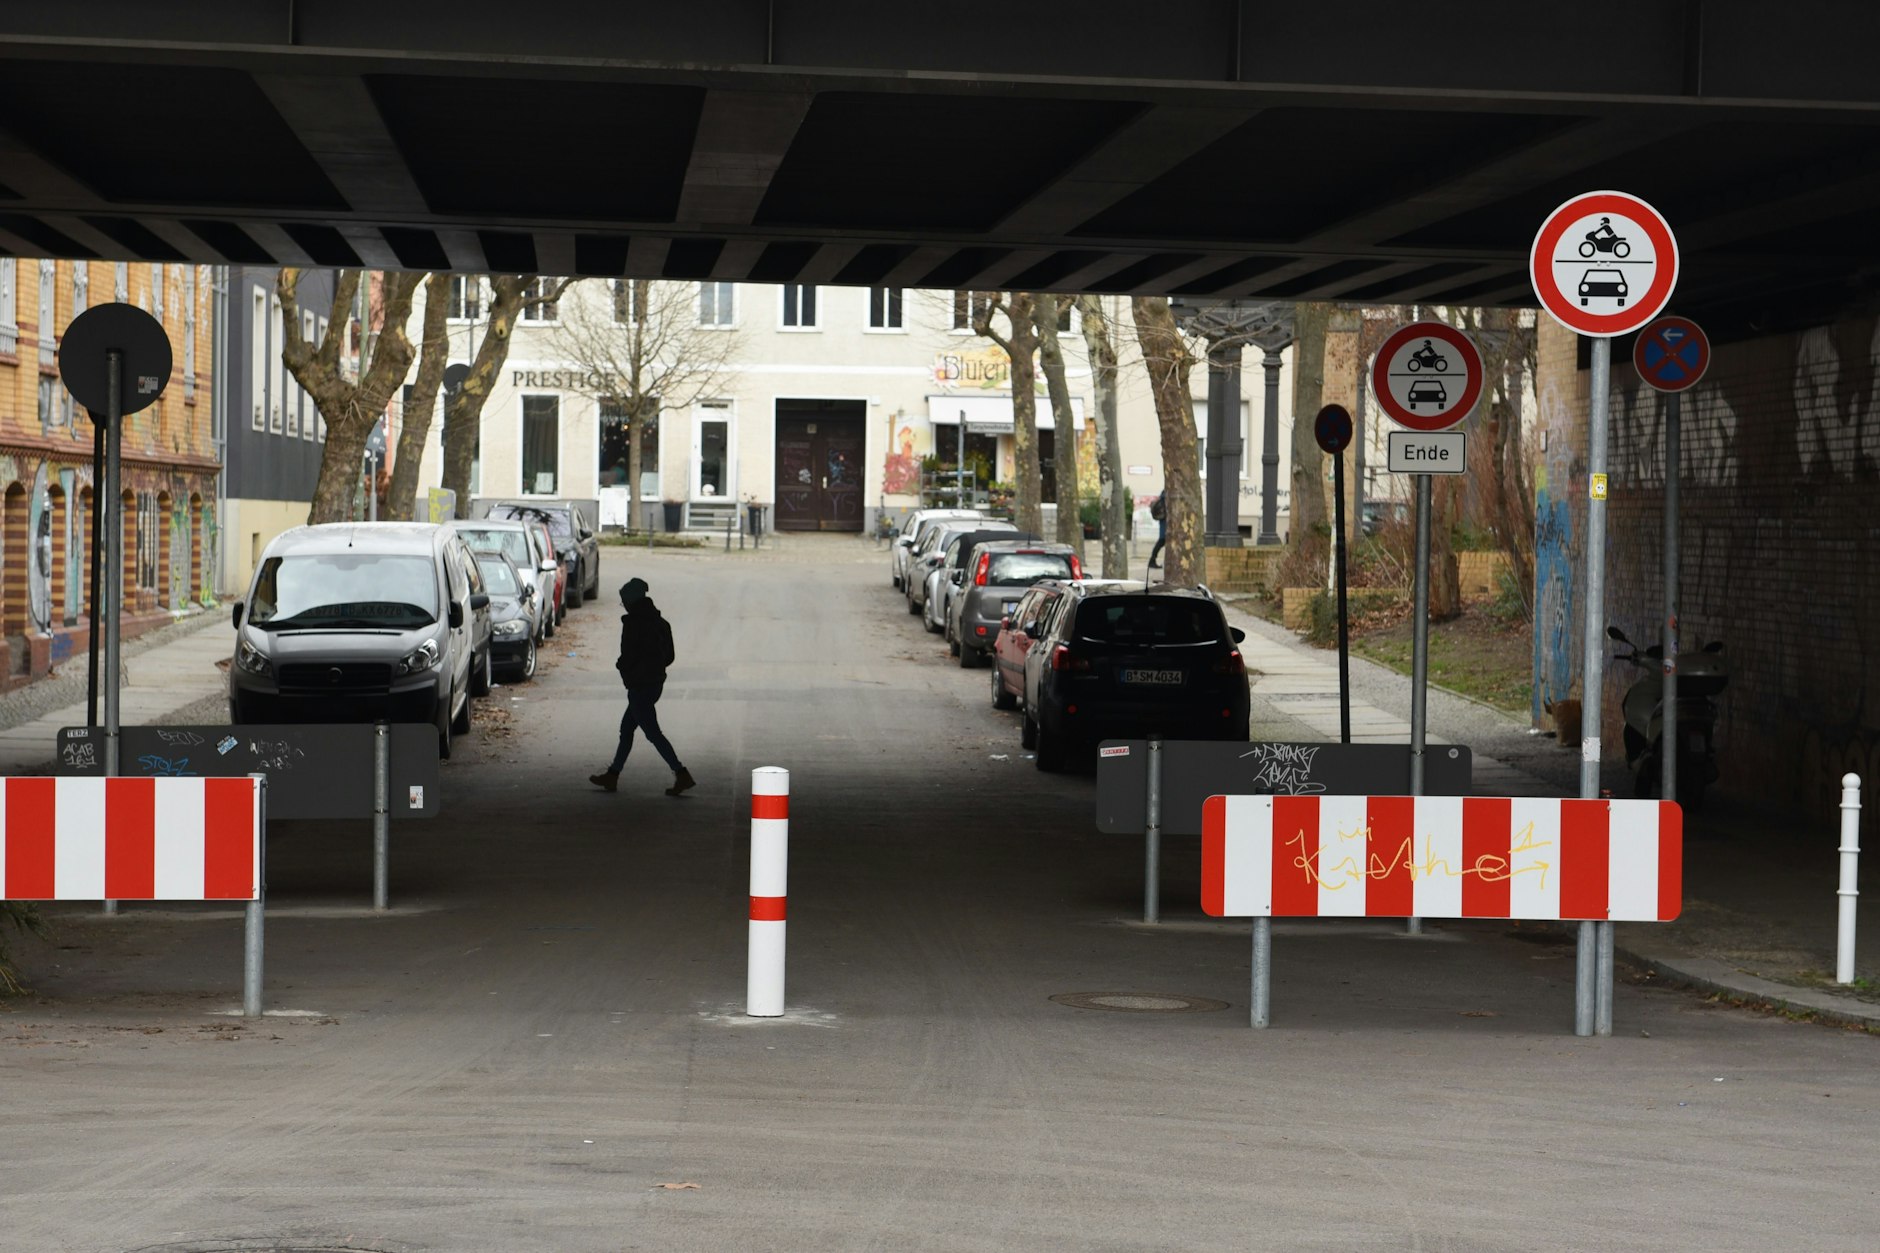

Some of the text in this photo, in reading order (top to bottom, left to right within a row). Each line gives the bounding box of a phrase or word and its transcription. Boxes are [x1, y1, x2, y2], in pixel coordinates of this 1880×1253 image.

[512, 371, 616, 389] PRESTIGE
[1404, 444, 1449, 461] Ende
[1126, 671, 1133, 681] B
[63, 742, 94, 757] ACAB
[65, 755, 97, 767] 161
[138, 754, 197, 776] STOLZ
